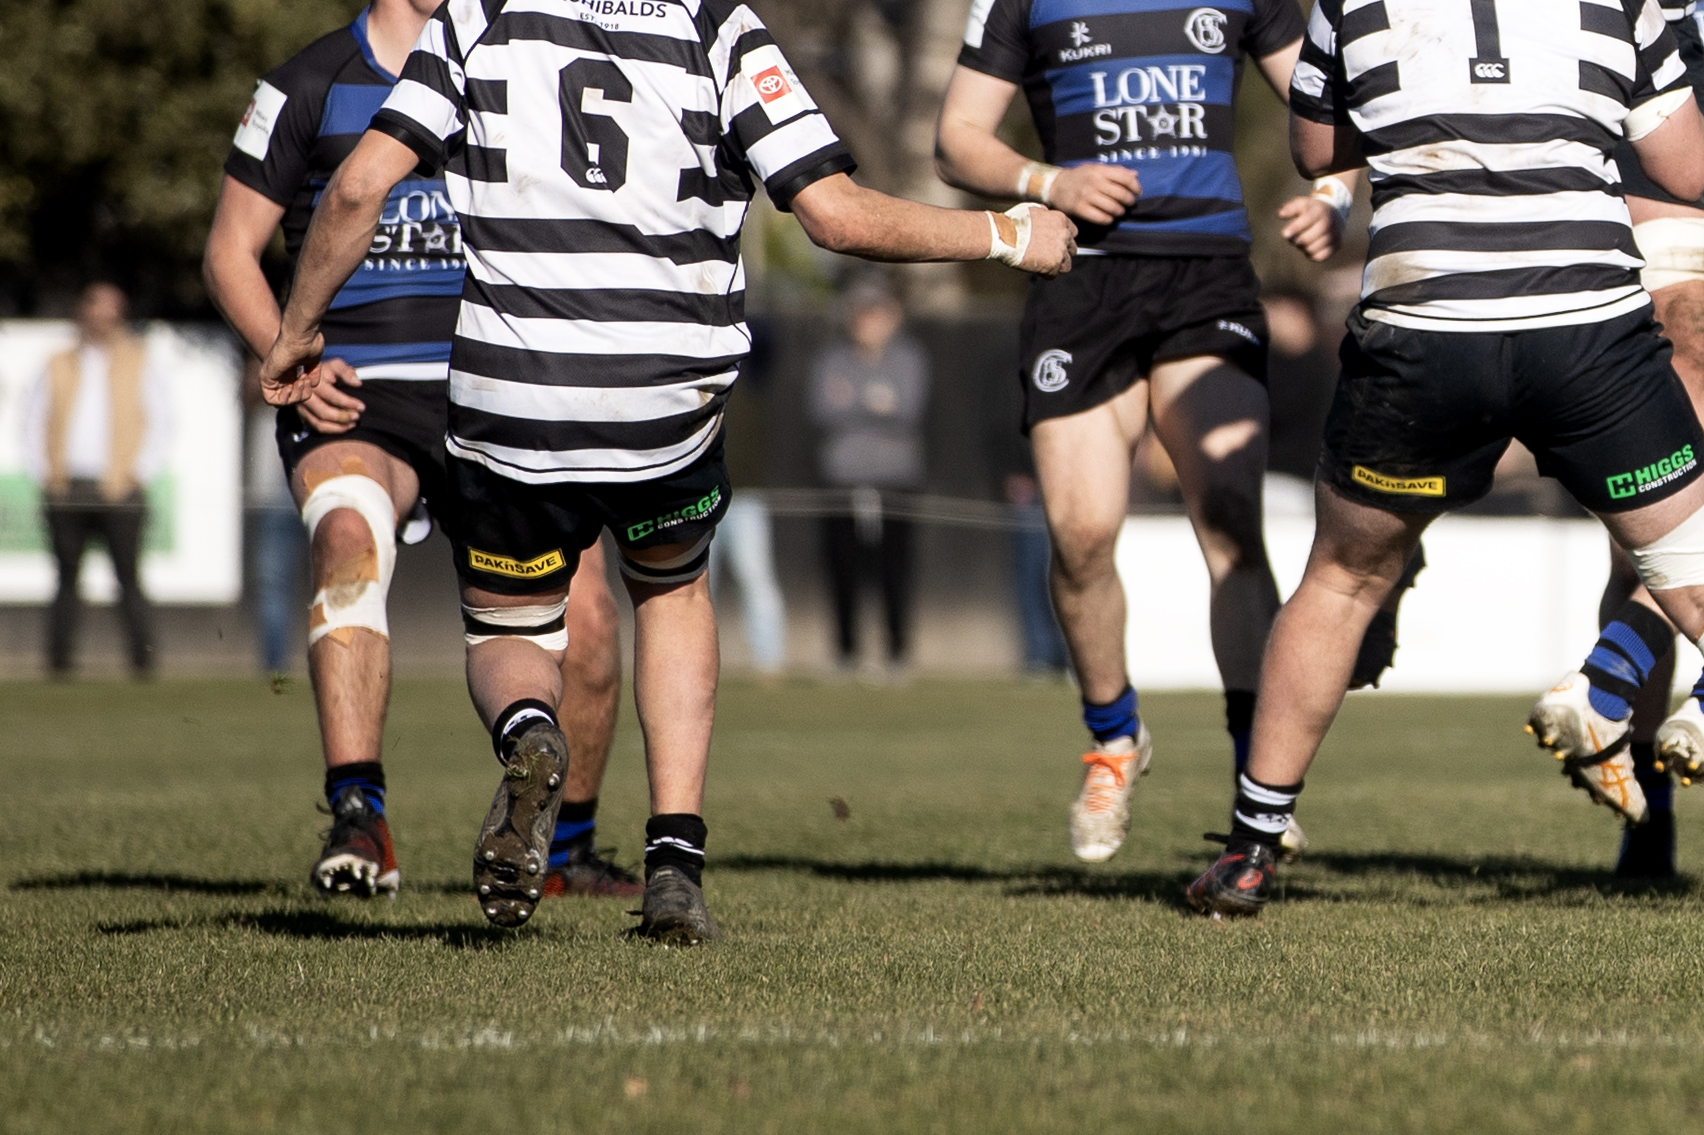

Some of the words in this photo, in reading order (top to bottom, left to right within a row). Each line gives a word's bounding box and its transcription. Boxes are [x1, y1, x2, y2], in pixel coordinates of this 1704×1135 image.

[1060, 44, 1112, 62] KUKRI
[1090, 64, 1206, 108] LONE
[558, 56, 633, 194] 6
[1098, 145, 1161, 164] SINCE
[363, 257, 431, 271] SINCE
[1635, 444, 1694, 485] HIGGS
[1638, 458, 1697, 494] CONSTRUCTION
[657, 485, 719, 524] HIGGS
